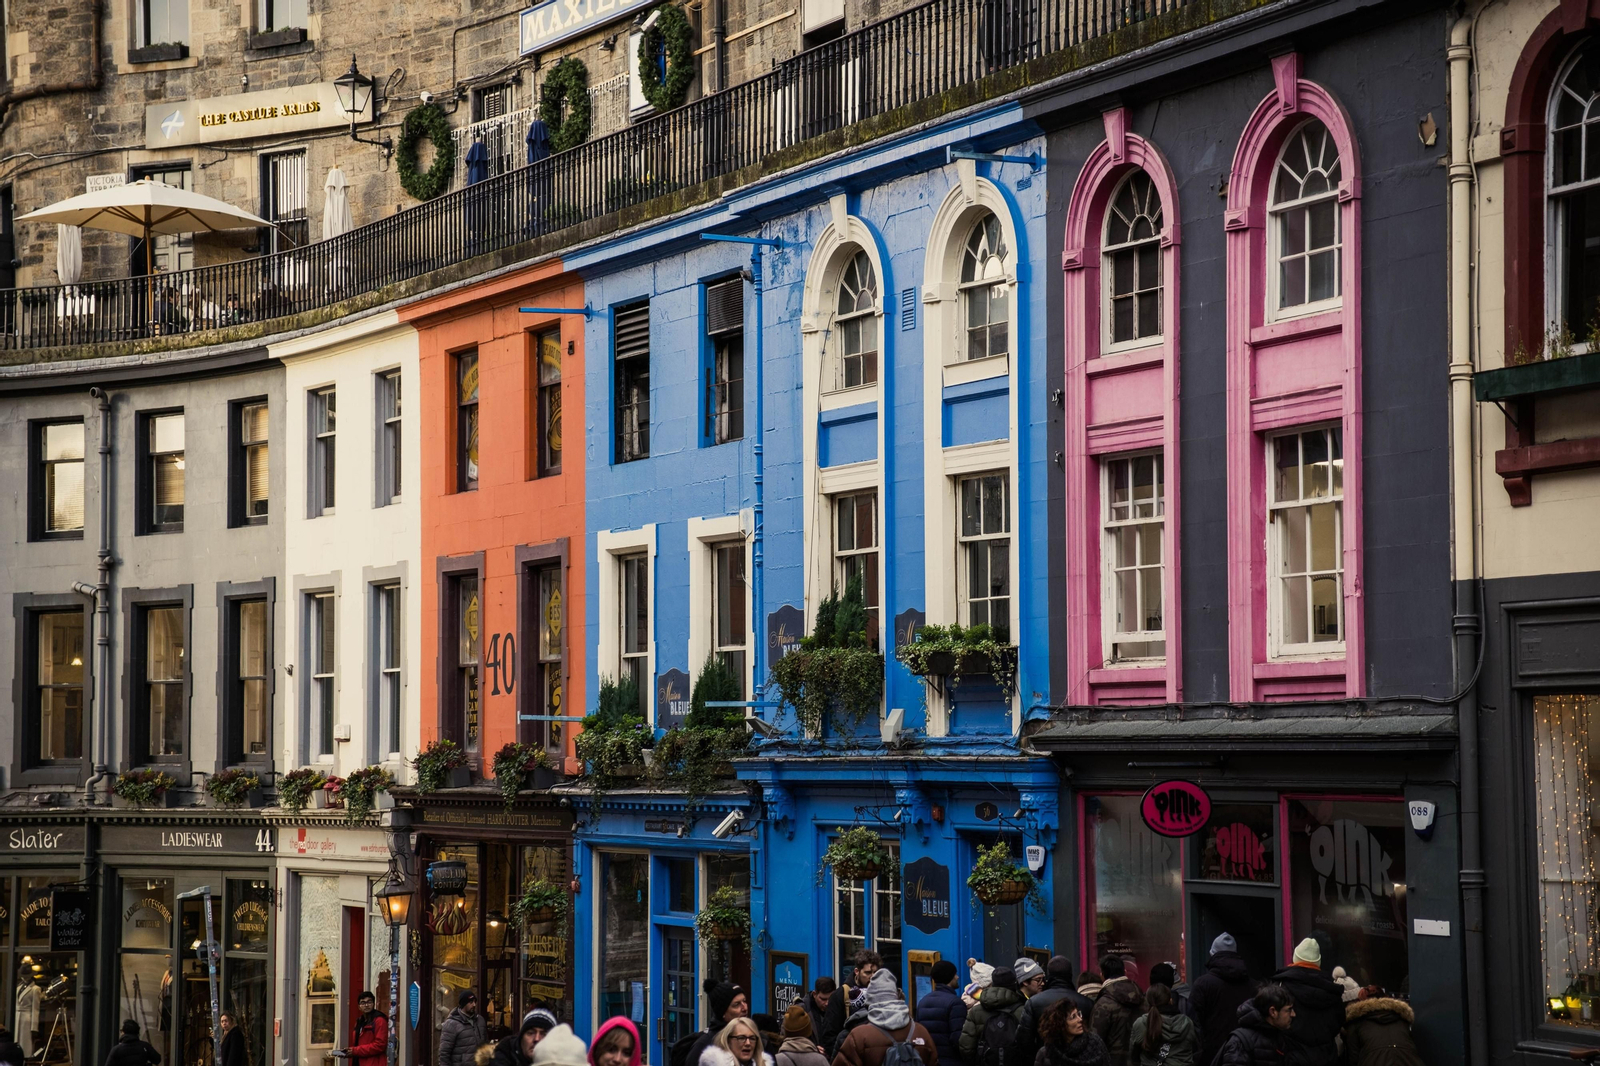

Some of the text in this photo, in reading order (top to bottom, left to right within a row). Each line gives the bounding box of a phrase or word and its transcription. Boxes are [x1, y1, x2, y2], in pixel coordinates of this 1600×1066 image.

[524, 0, 640, 44] MAXI
[198, 101, 320, 126] THE CASTLE ARMS
[89, 175, 123, 185] VICTORIA
[549, 604, 561, 620] BES
[486, 633, 516, 696] 40
[671, 701, 692, 716] BLEUE
[446, 811, 467, 827] Officially
[467, 812, 486, 824] Licensed
[487, 813, 506, 825] HARRY
[506, 814, 529, 826] POTTER
[530, 814, 562, 827] Merchandise
[9, 828, 63, 849] Slater
[162, 832, 223, 848] LADIESWEAR
[320, 837, 337, 854] gallery
[432, 868, 467, 879] MUSEUM
[433, 881, 466, 889] CONTEXT
[905, 876, 937, 902] Maison
[20, 900, 40, 921] MADE
[40, 897, 49, 907] TO
[141, 898, 172, 923] ACCESSORIES
[922, 899, 950, 917] BLEUE
[528, 935, 567, 964] MUSEUM
